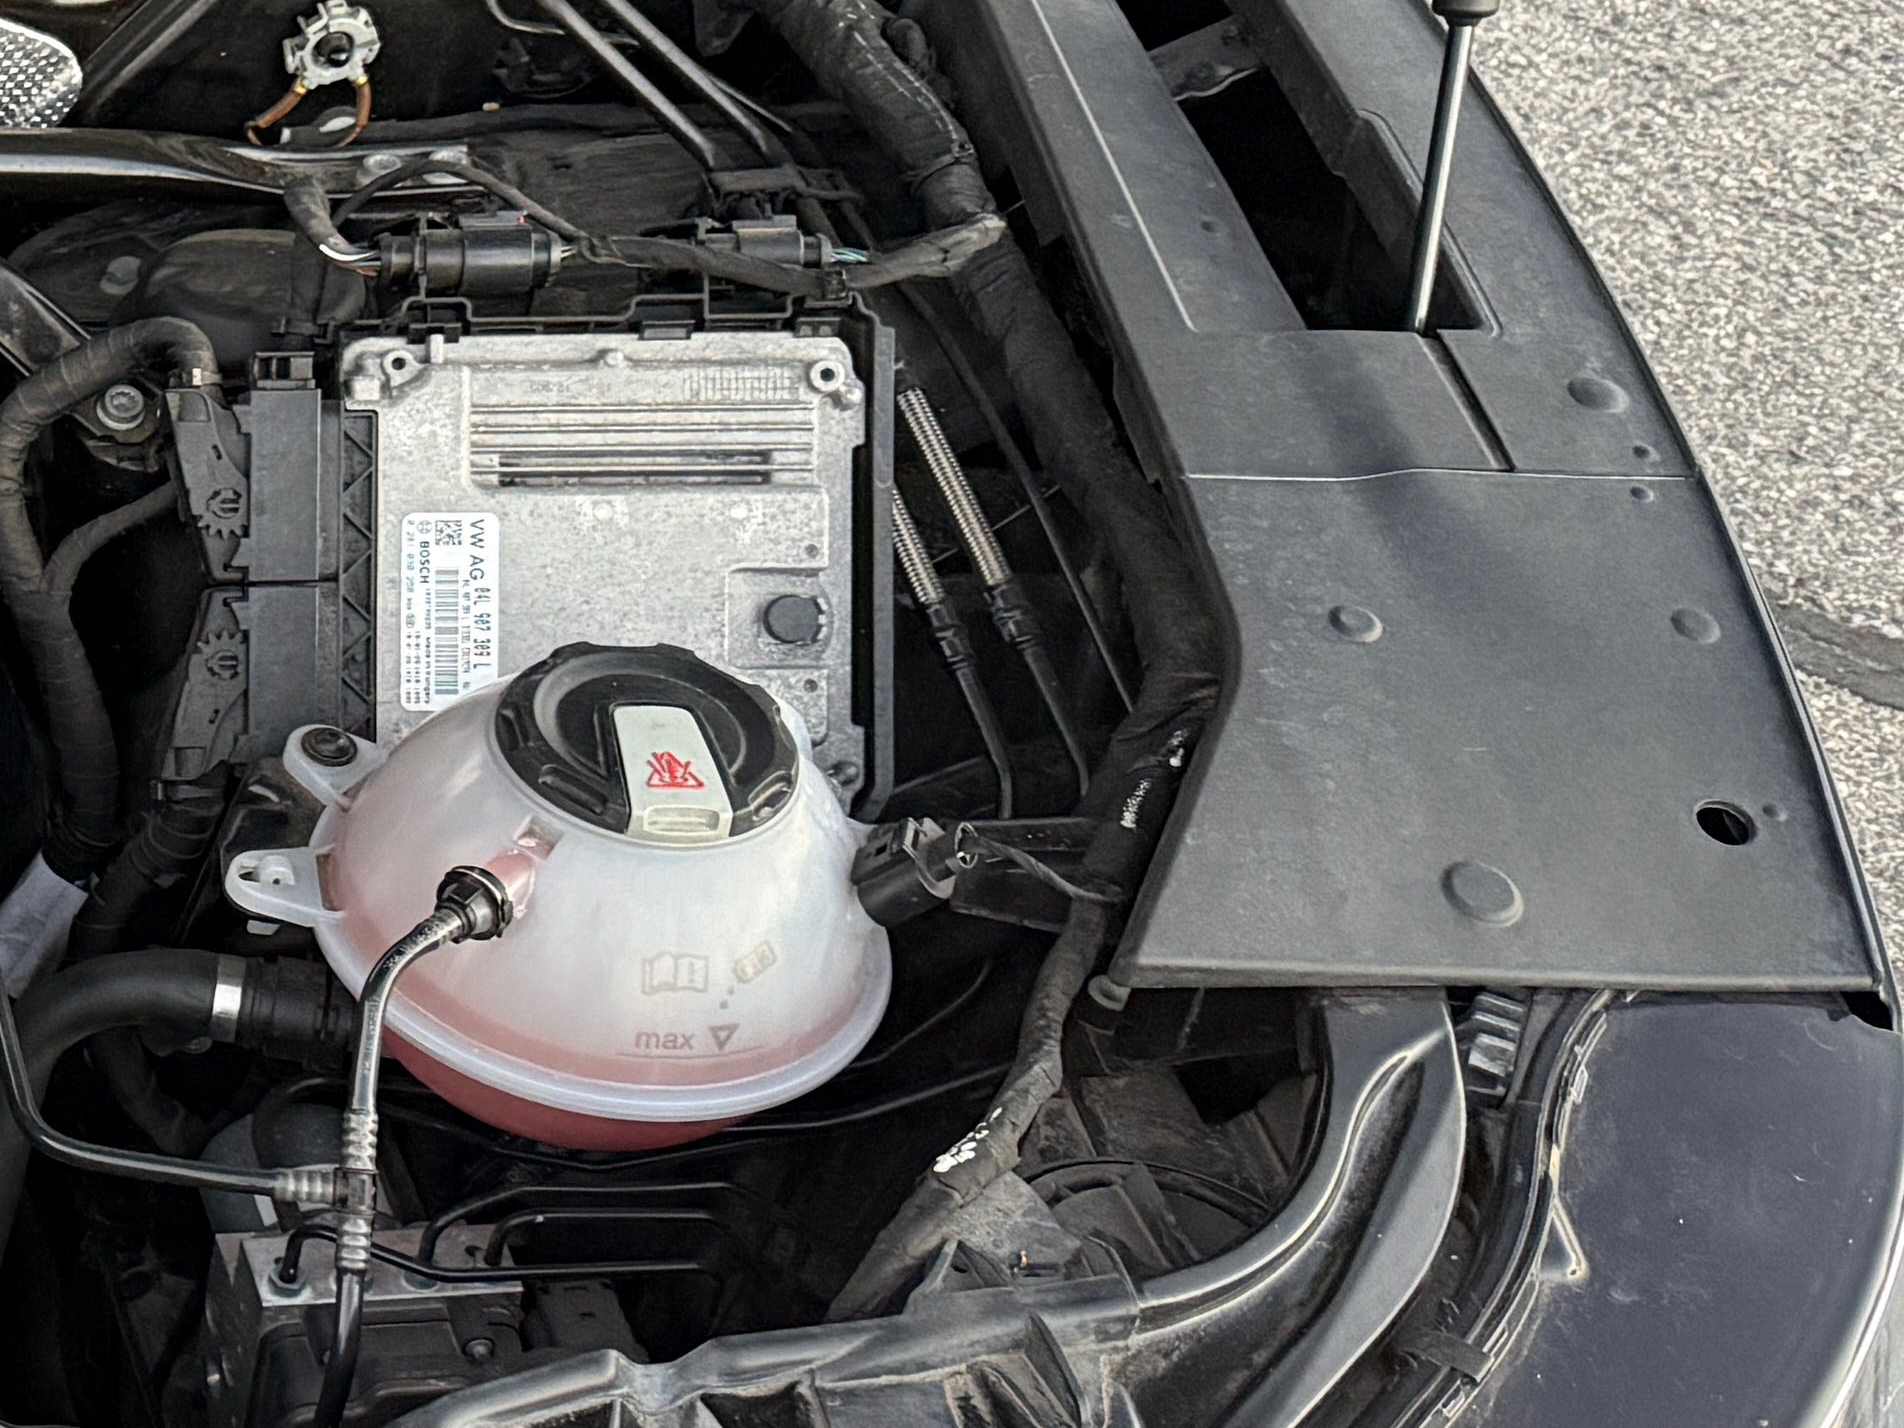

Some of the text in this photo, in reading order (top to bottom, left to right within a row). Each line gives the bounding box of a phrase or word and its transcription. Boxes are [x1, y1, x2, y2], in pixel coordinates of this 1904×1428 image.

[469, 519, 485, 580] VW AG
[419, 541, 430, 584] BOSCH
[474, 587, 491, 606] 04L
[474, 612, 491, 632] 907
[474, 638, 491, 656] 309
[635, 1030, 694, 1052] max
